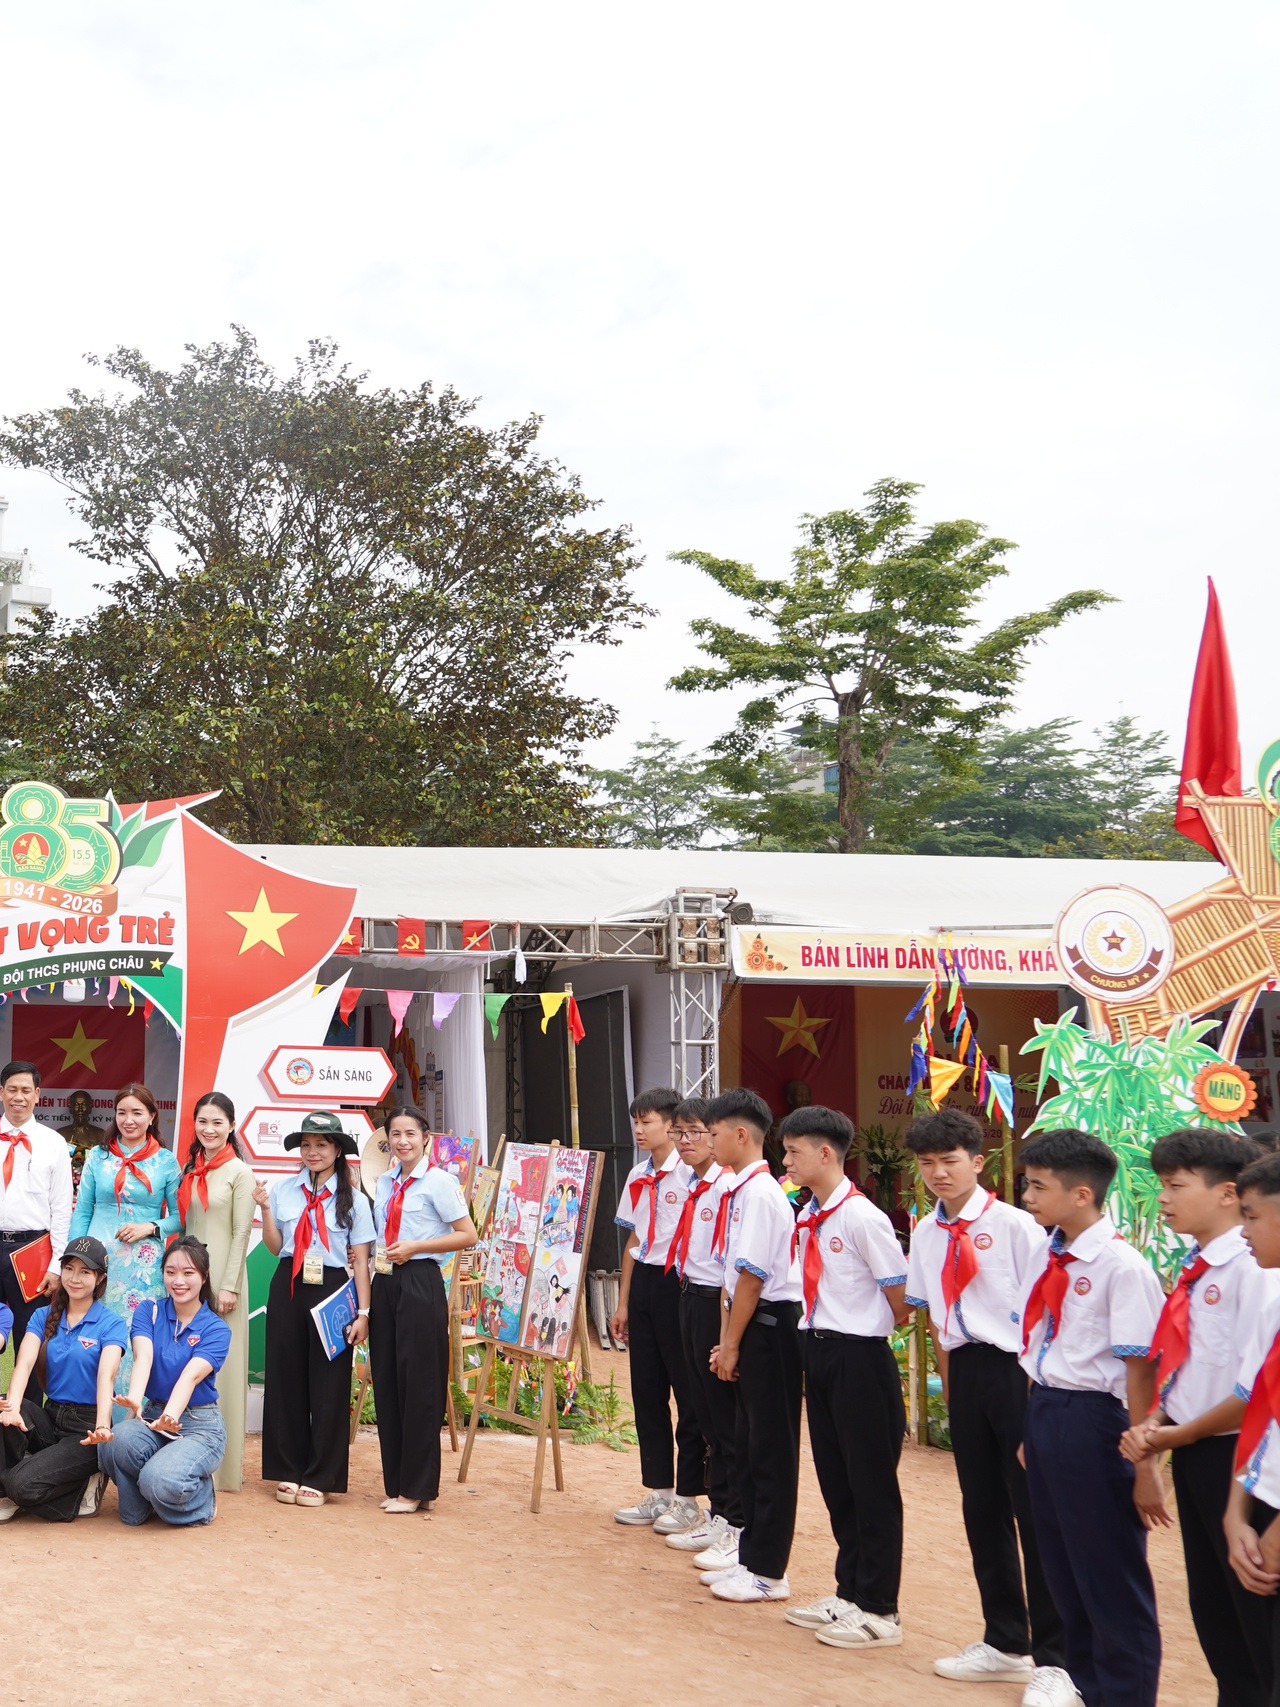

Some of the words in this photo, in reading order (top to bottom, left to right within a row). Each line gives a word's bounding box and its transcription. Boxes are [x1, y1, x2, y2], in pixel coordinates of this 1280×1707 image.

[72, 849, 91, 860] 15.5
[3, 881, 46, 901] 1941
[60, 893, 104, 914] 2026
[18, 916, 110, 953] VỌNG
[119, 911, 175, 945] TRẺ
[801, 939, 839, 968] BẢN
[846, 942, 889, 970] LĨNH
[895, 940, 936, 970] DẪN
[1019, 945, 1059, 972] KHÁ
[3, 968, 24, 990] ĐỘI
[27, 964, 59, 981] THCS
[63, 959, 106, 979] PHỤNG
[109, 955, 144, 970] CHÂU
[319, 1066, 340, 1080] SẴN
[344, 1068, 373, 1082] SÀNG
[1208, 1079, 1242, 1101] MĂNG
